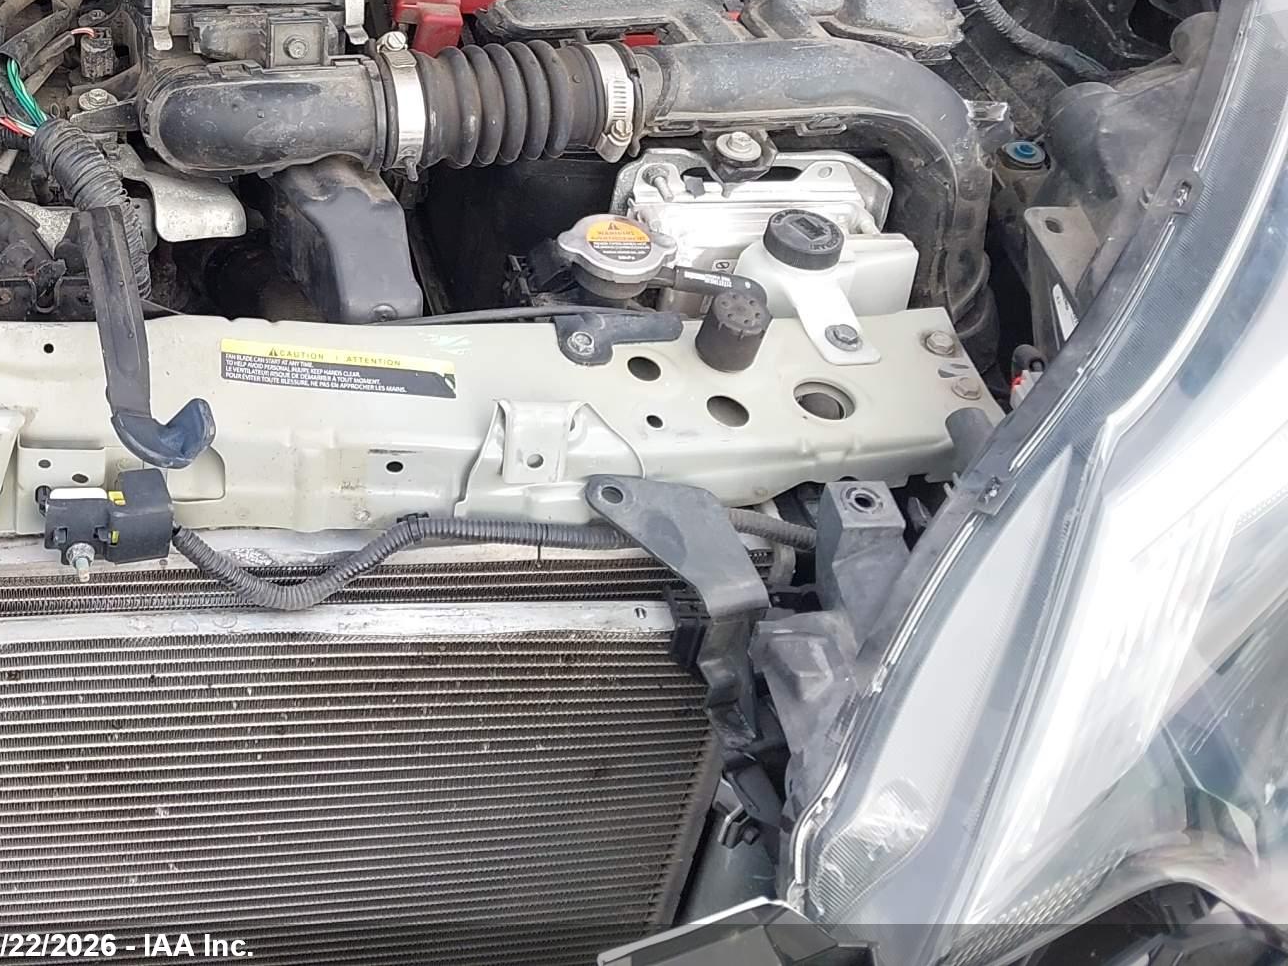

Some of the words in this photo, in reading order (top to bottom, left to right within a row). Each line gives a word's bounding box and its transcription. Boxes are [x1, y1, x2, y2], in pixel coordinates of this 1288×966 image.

[236, 354, 253, 362] BLADE
[265, 357, 281, 365] START
[279, 350, 324, 360] CAUTION
[346, 356, 401, 366] ATTENTION
[337, 375, 353, 383] TOUT
[339, 383, 375, 391] APPROCHER
